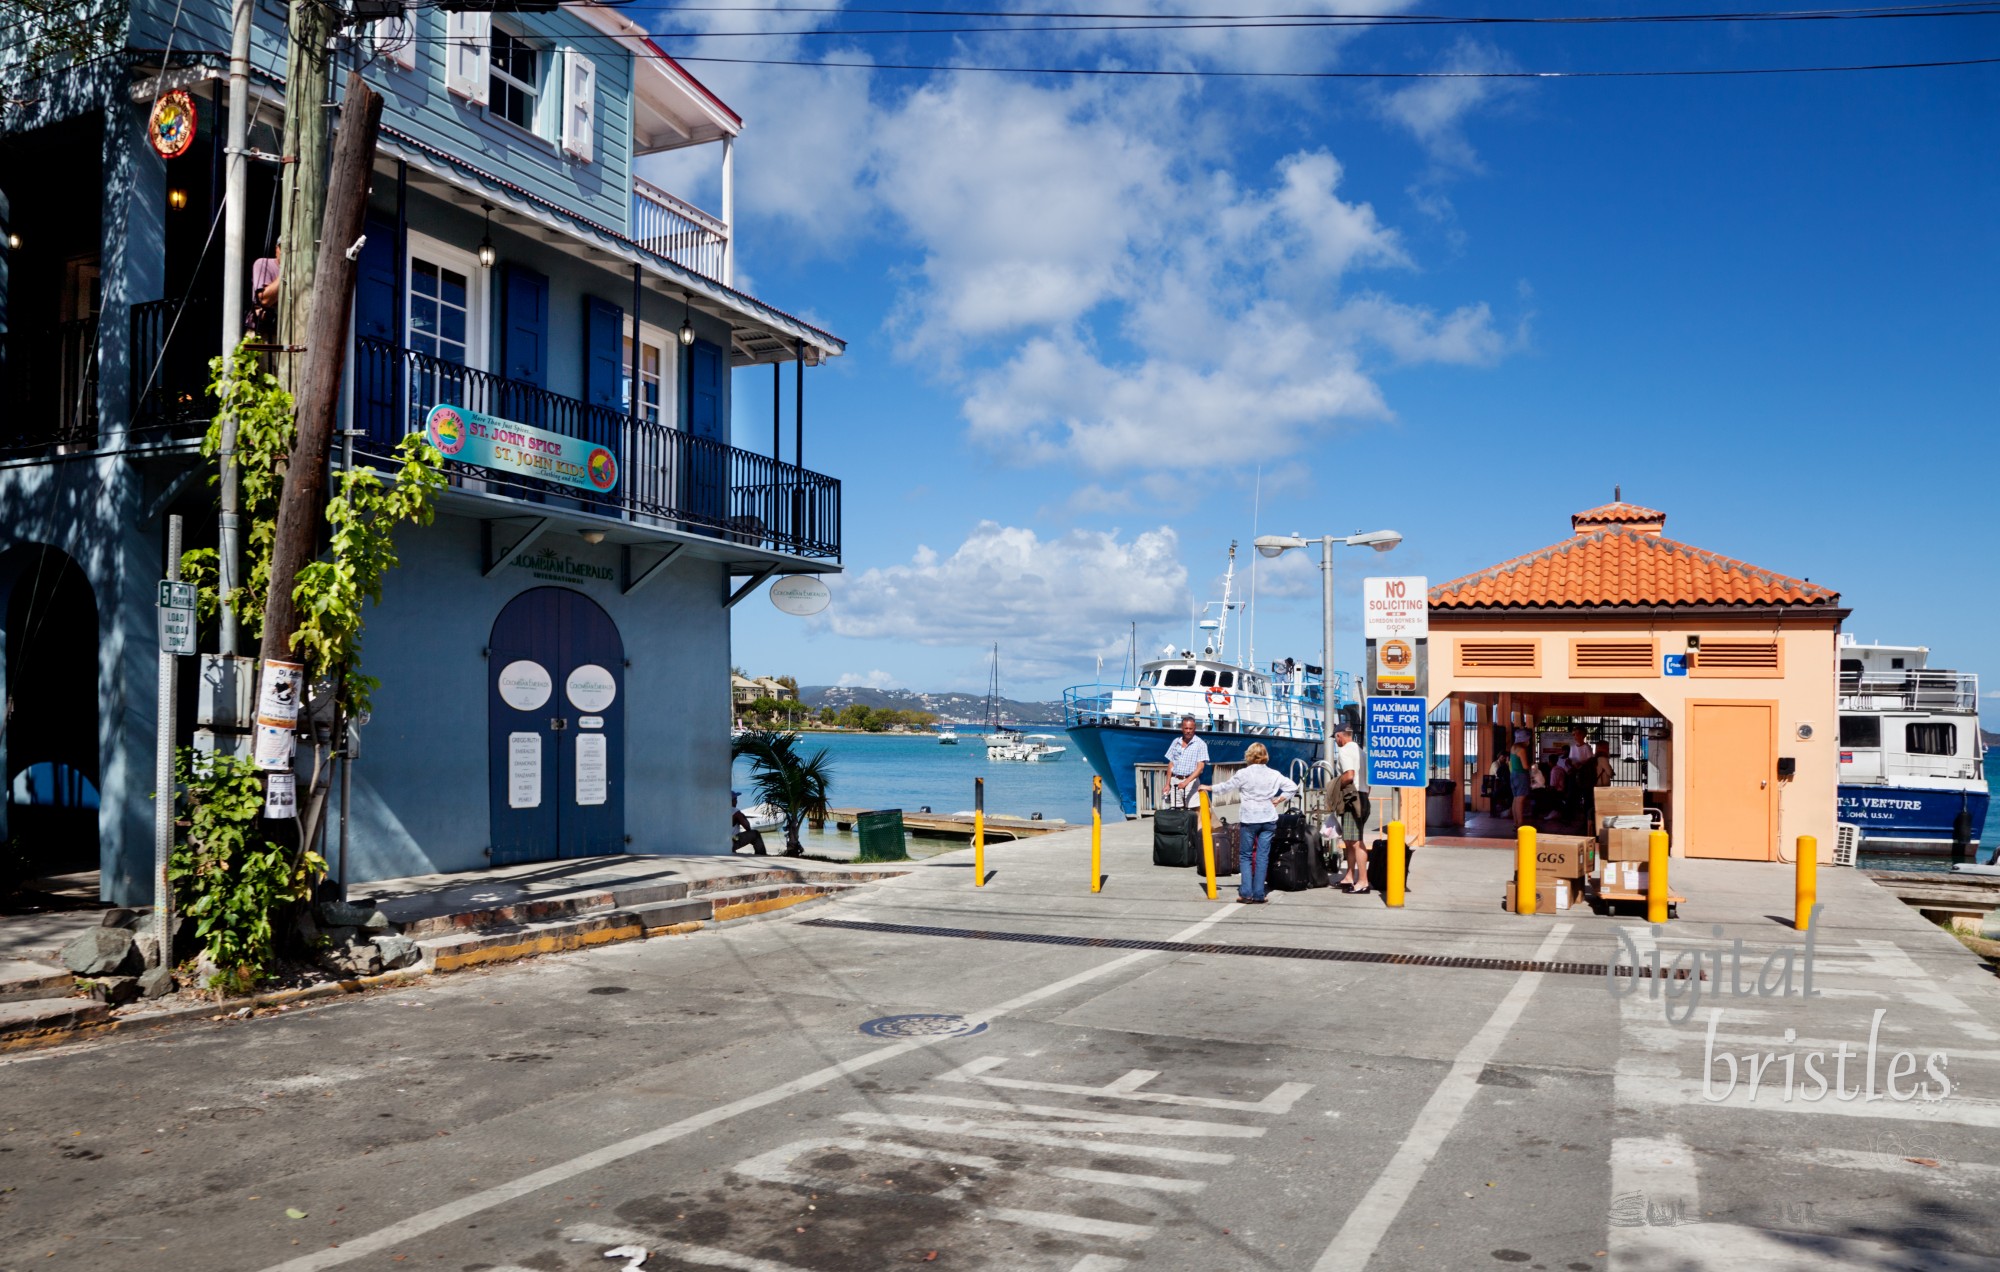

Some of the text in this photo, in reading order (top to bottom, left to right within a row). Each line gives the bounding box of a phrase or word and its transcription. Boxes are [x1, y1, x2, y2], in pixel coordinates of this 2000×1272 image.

[446, 410, 464, 429] JOHN
[472, 414, 486, 423] More
[487, 418, 501, 426] Than
[470, 422, 562, 457] ST. JOHN SPICE
[437, 441, 459, 453] SPICE
[495, 446, 513, 462] ST.
[516, 450, 553, 471] JOHN
[555, 460, 585, 479] KIDS
[565, 556, 614, 581] EMERALDS
[533, 572, 584, 585] INTERNATIONAL
[162, 585, 170, 605] 5
[1385, 580, 1406, 598] NO
[172, 596, 193, 607] PARKING
[1369, 600, 1423, 610] SOLICITING
[167, 612, 184, 623] LOAD
[168, 636, 185, 647] ZONE
[1372, 703, 1420, 712] MAXIMUM
[1373, 714, 1420, 723] FINE FOR
[1371, 725, 1422, 734] LITTERING
[1371, 735, 1422, 748] $1000.00
[1369, 749, 1424, 759] MULTA POR
[1374, 760, 1420, 770] ARROJAR
[1376, 771, 1416, 780] BASURA
[1862, 798, 1922, 810] VENTURE
